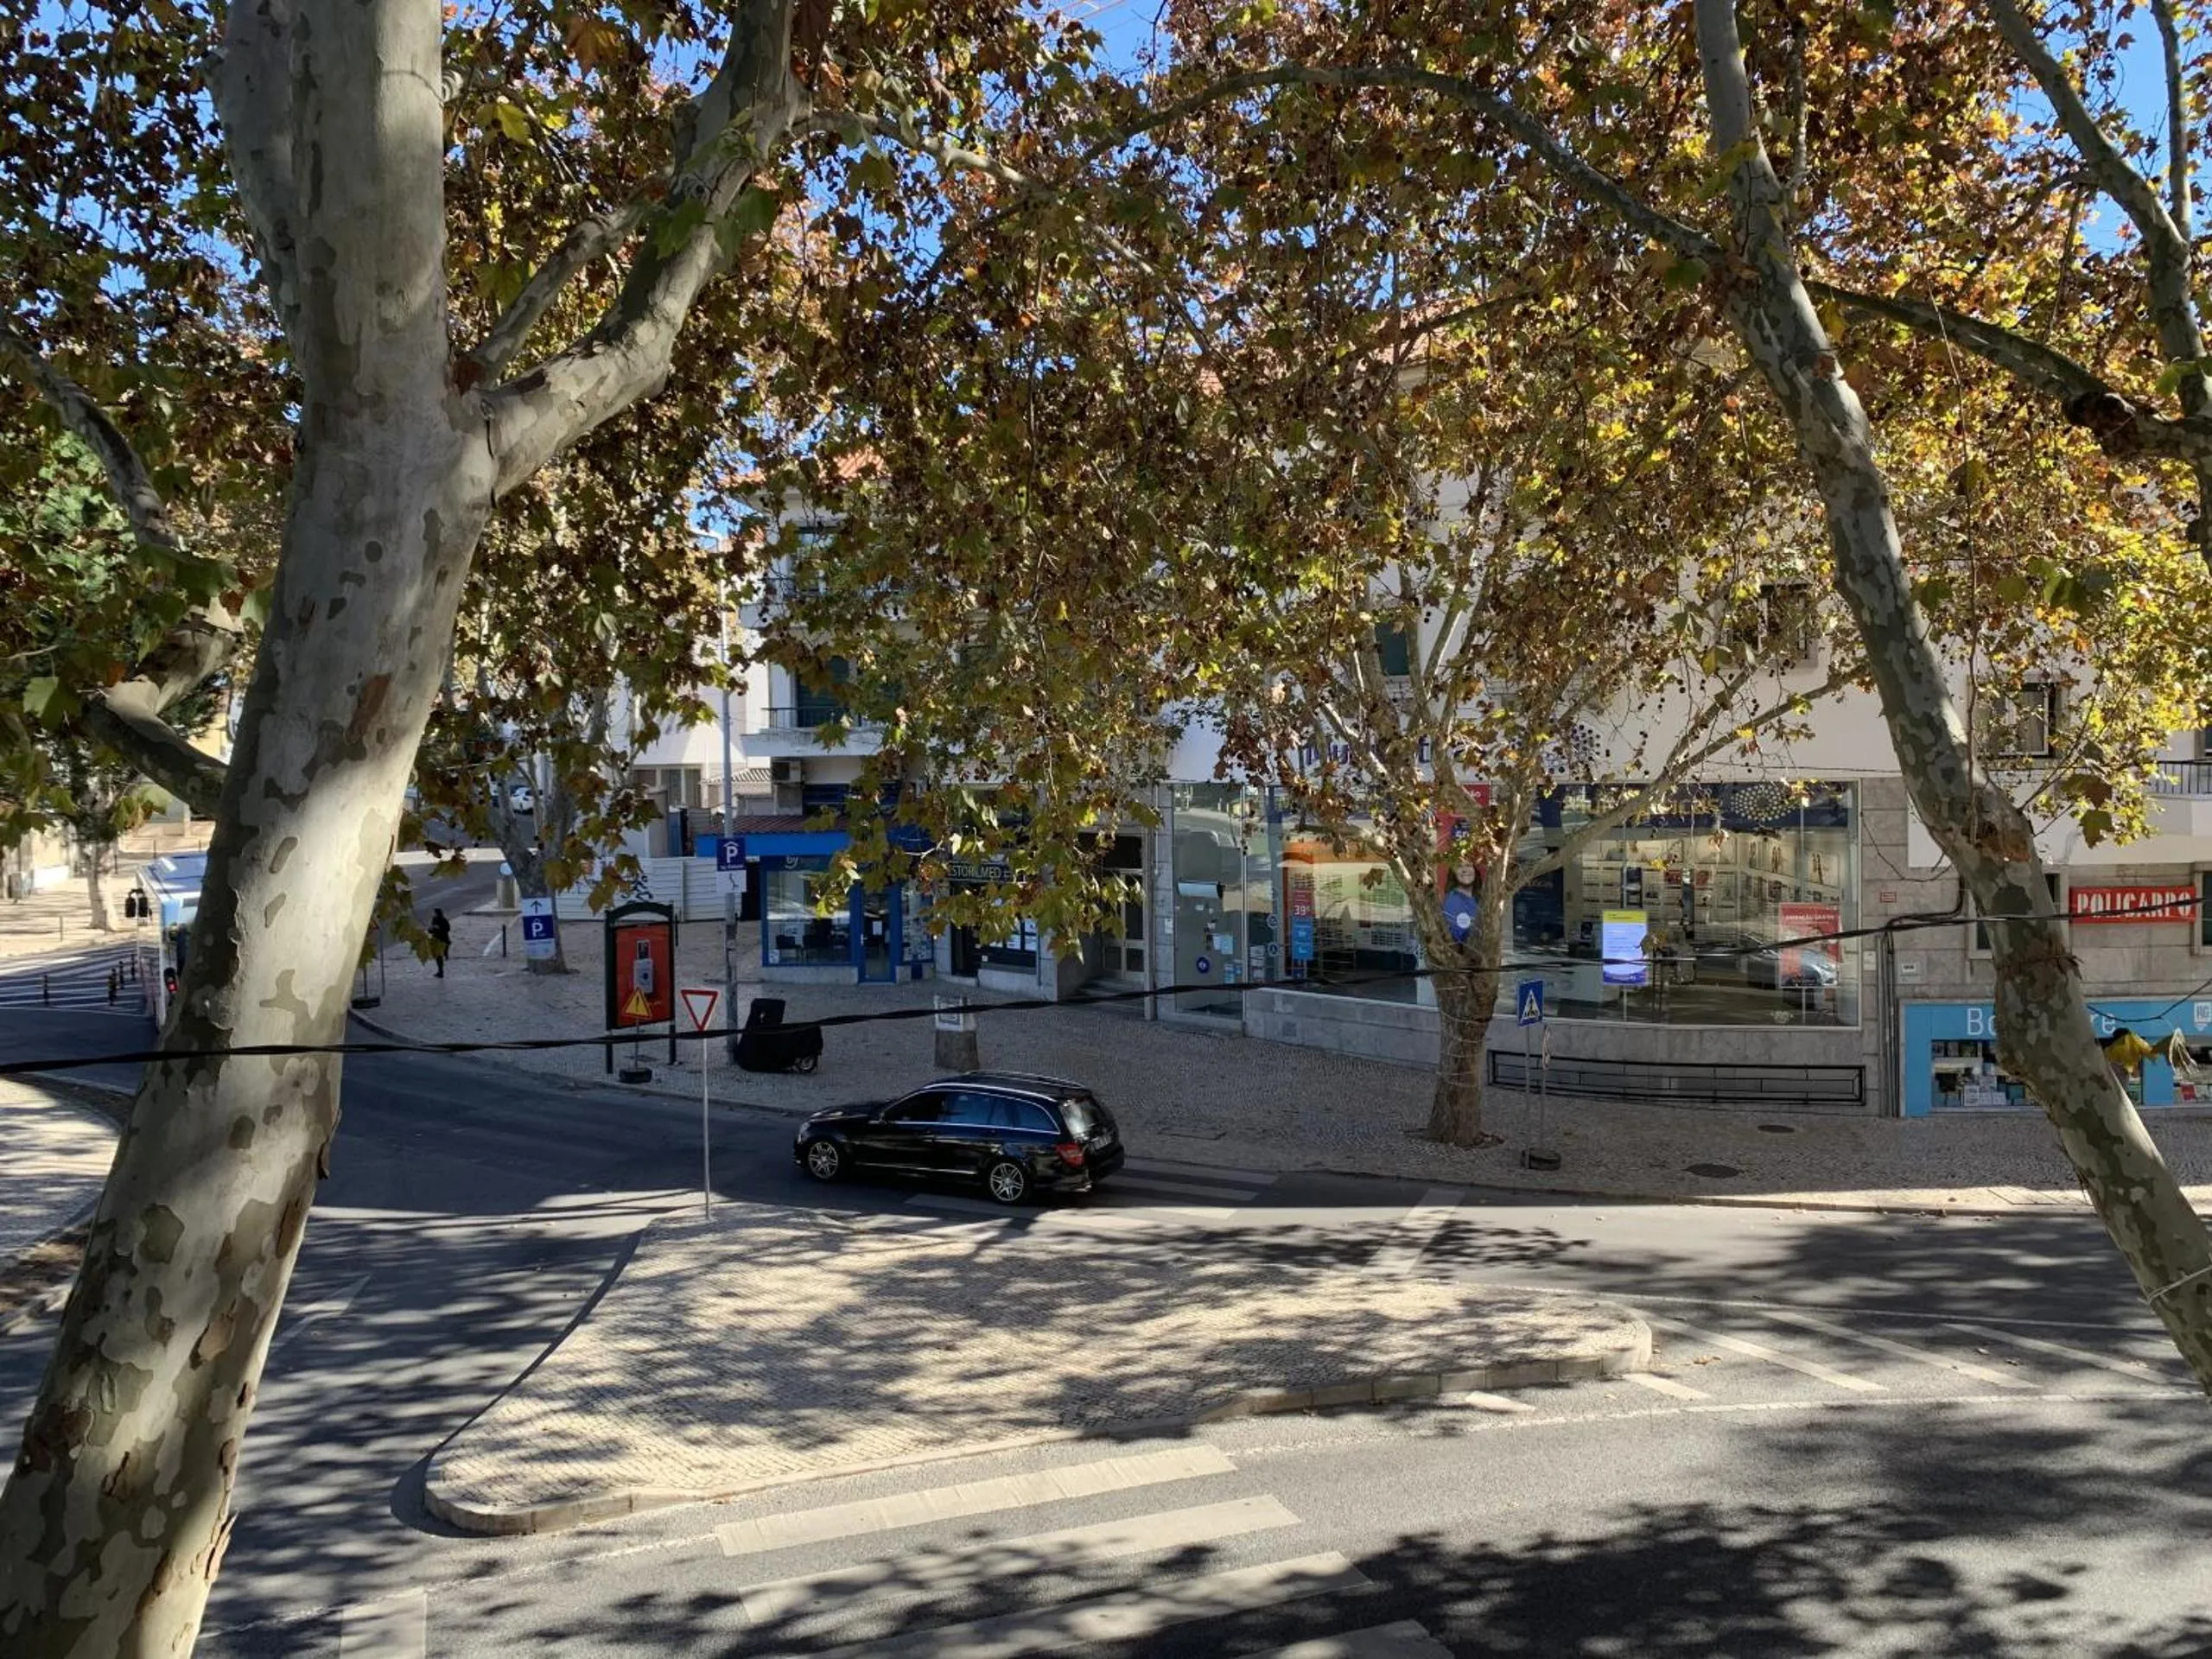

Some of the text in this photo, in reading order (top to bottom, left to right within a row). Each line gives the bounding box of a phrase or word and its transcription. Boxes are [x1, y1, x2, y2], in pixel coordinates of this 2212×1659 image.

[727, 847, 738, 863] P
[2077, 891, 2191, 918] POLICARPO
[532, 922, 543, 938] P
